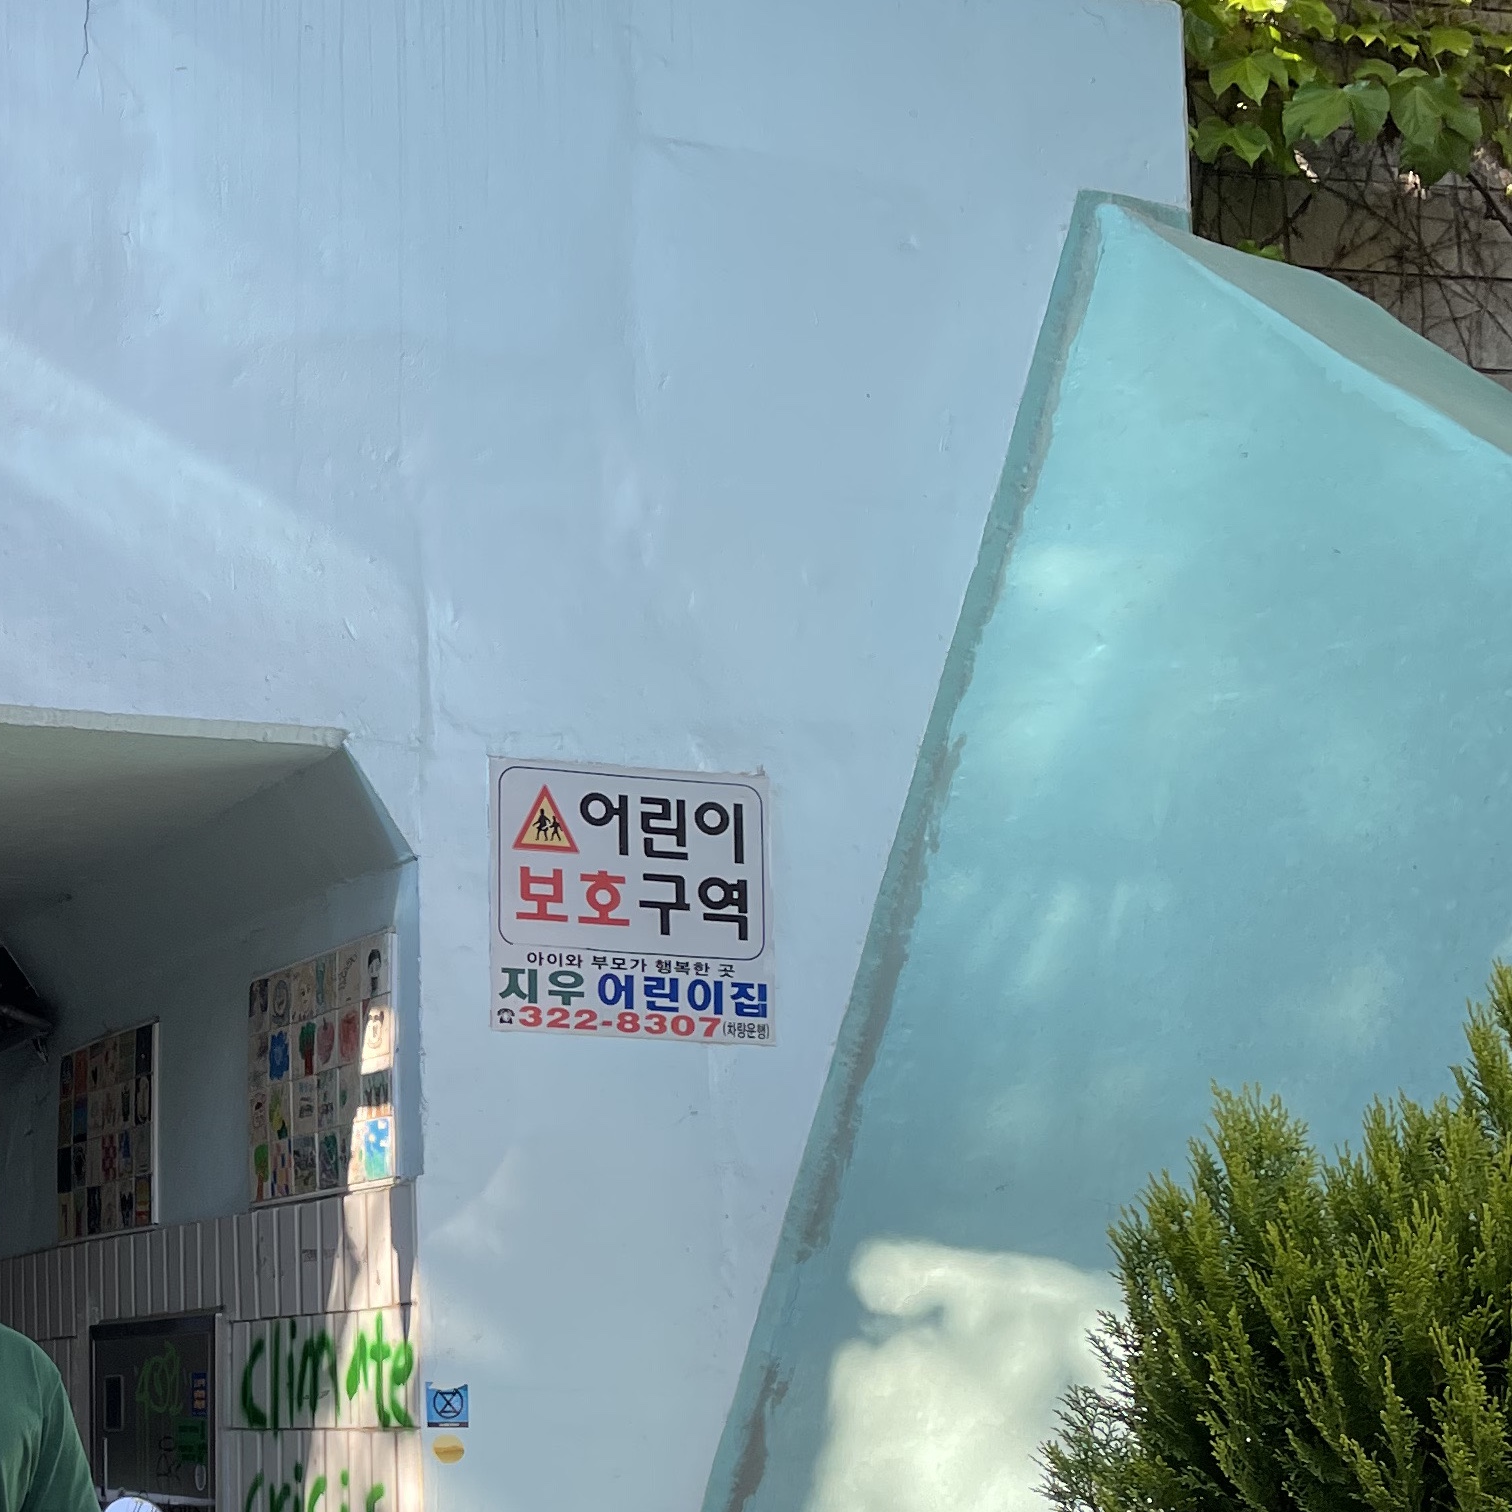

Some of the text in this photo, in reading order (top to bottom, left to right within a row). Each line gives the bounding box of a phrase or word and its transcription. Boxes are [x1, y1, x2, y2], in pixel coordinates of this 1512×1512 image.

[579, 792, 745, 864] 어린이
[516, 866, 749, 941] 보호구역
[527, 951, 736, 979] 아이와 부모가 행복한 곳
[499, 967, 768, 1019] 지우 어린이집
[518, 1005, 722, 1039] 322-8307
